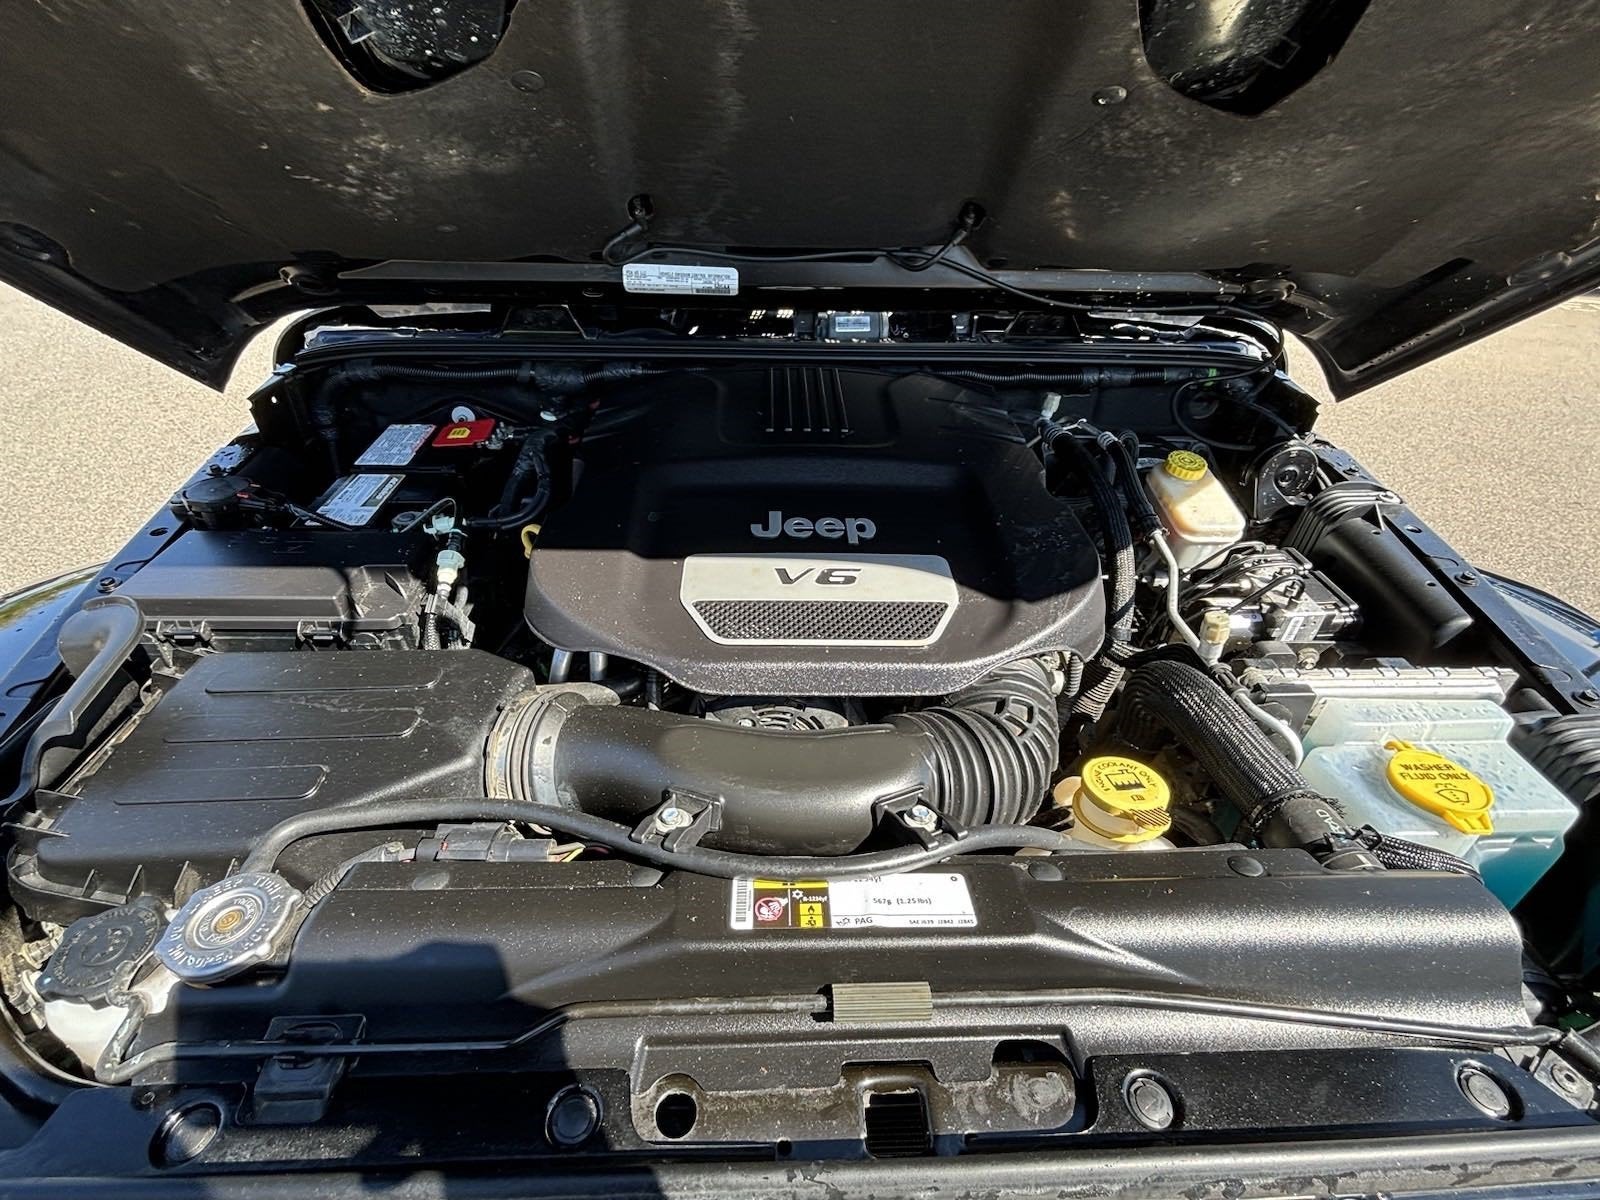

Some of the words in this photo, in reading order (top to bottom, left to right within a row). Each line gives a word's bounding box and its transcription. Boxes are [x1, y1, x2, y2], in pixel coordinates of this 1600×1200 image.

[750, 510, 877, 544] Jeep
[774, 567, 862, 585] V6
[1399, 763, 1456, 771] WASHER
[1097, 761, 1138, 771] COOLANT
[1138, 770, 1157, 788] ONLY
[1399, 772, 1437, 780] FLUID
[1438, 772, 1471, 780] ONLY
[854, 916, 873, 925] PAG
